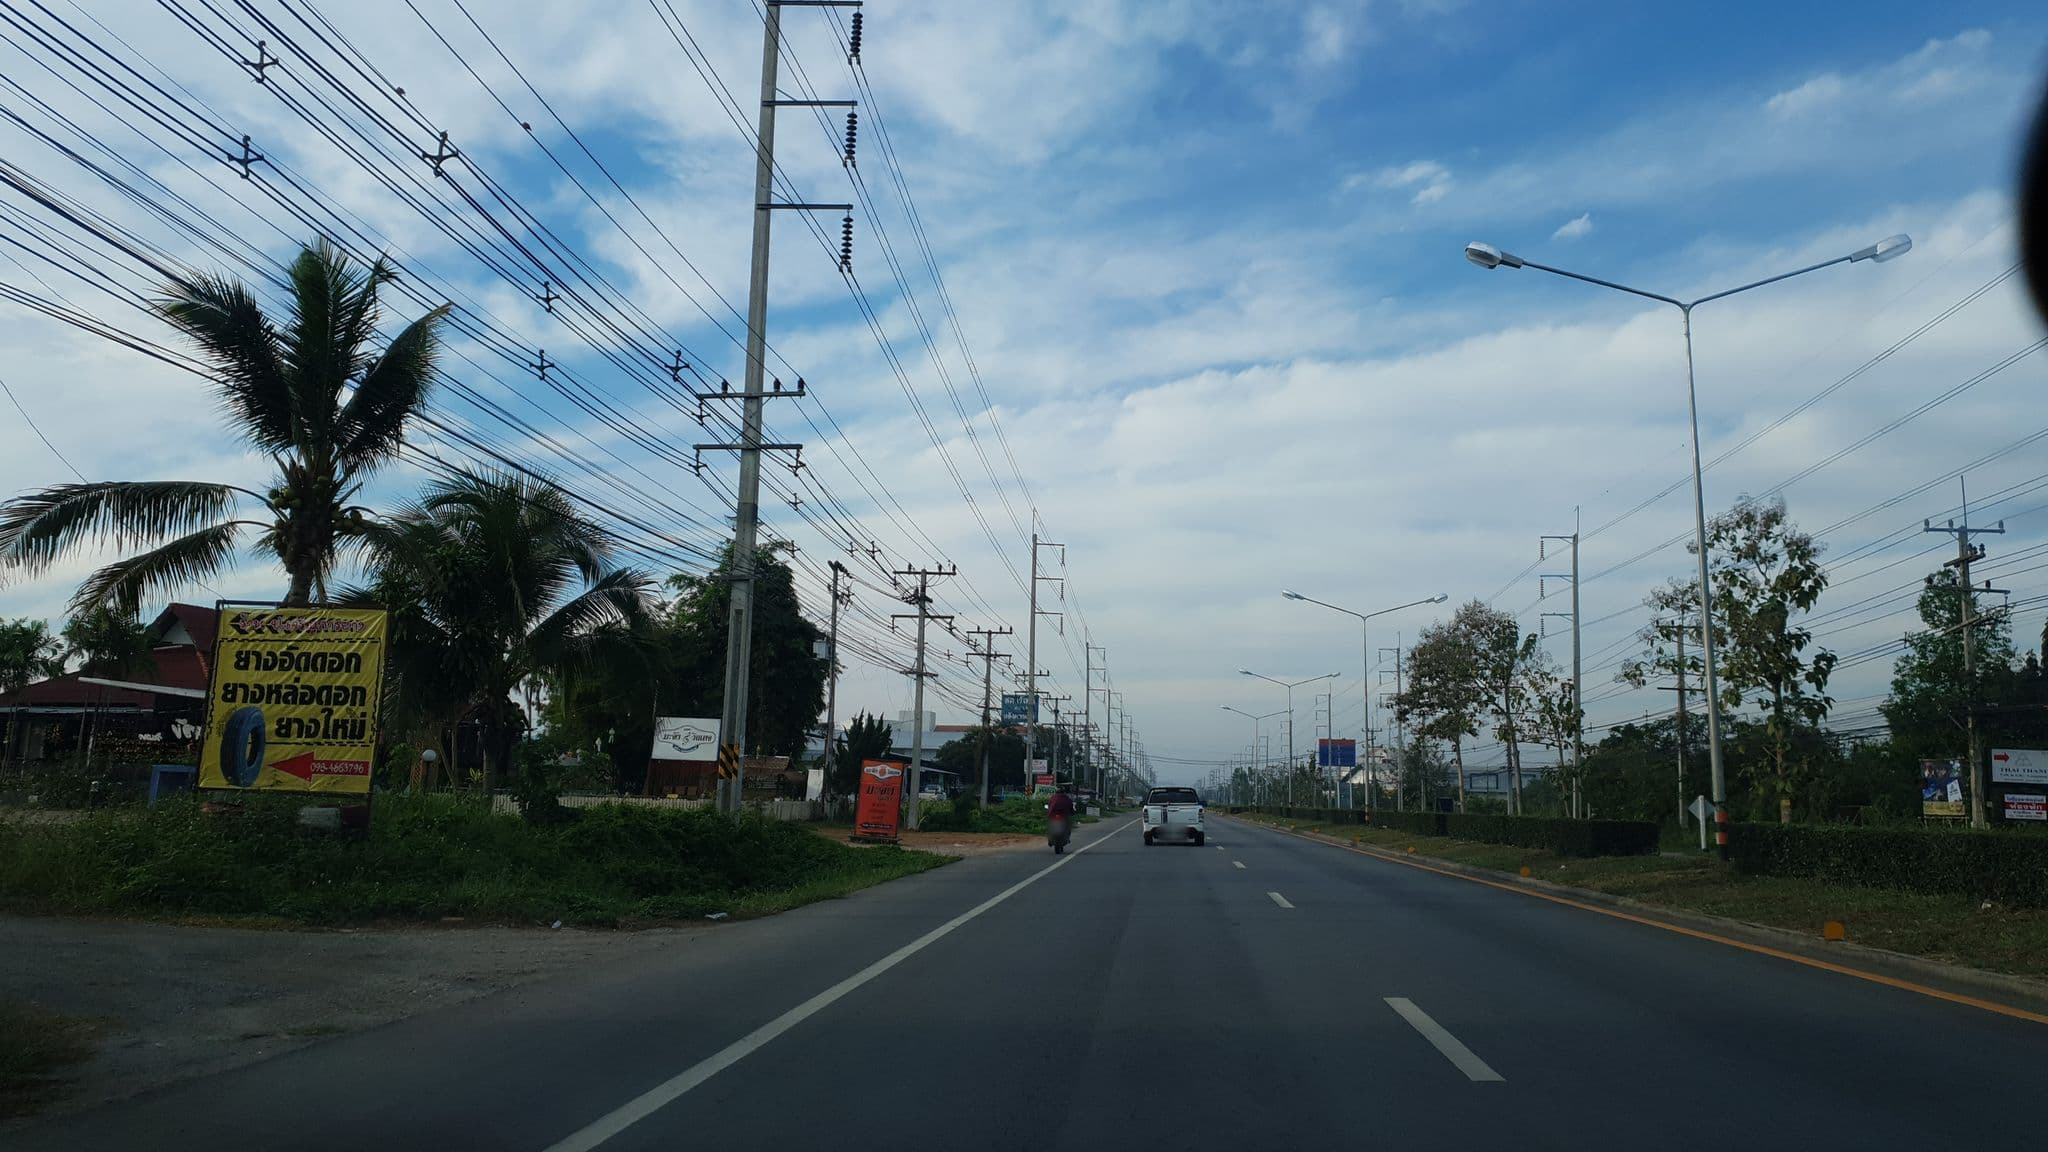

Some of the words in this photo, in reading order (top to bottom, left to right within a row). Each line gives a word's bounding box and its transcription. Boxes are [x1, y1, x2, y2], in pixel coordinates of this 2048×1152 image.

[234, 645, 361, 673] ยางอัดดอก
[221, 677, 367, 706] ยางหล่อดอก
[274, 707, 366, 740] ยางใหม่
